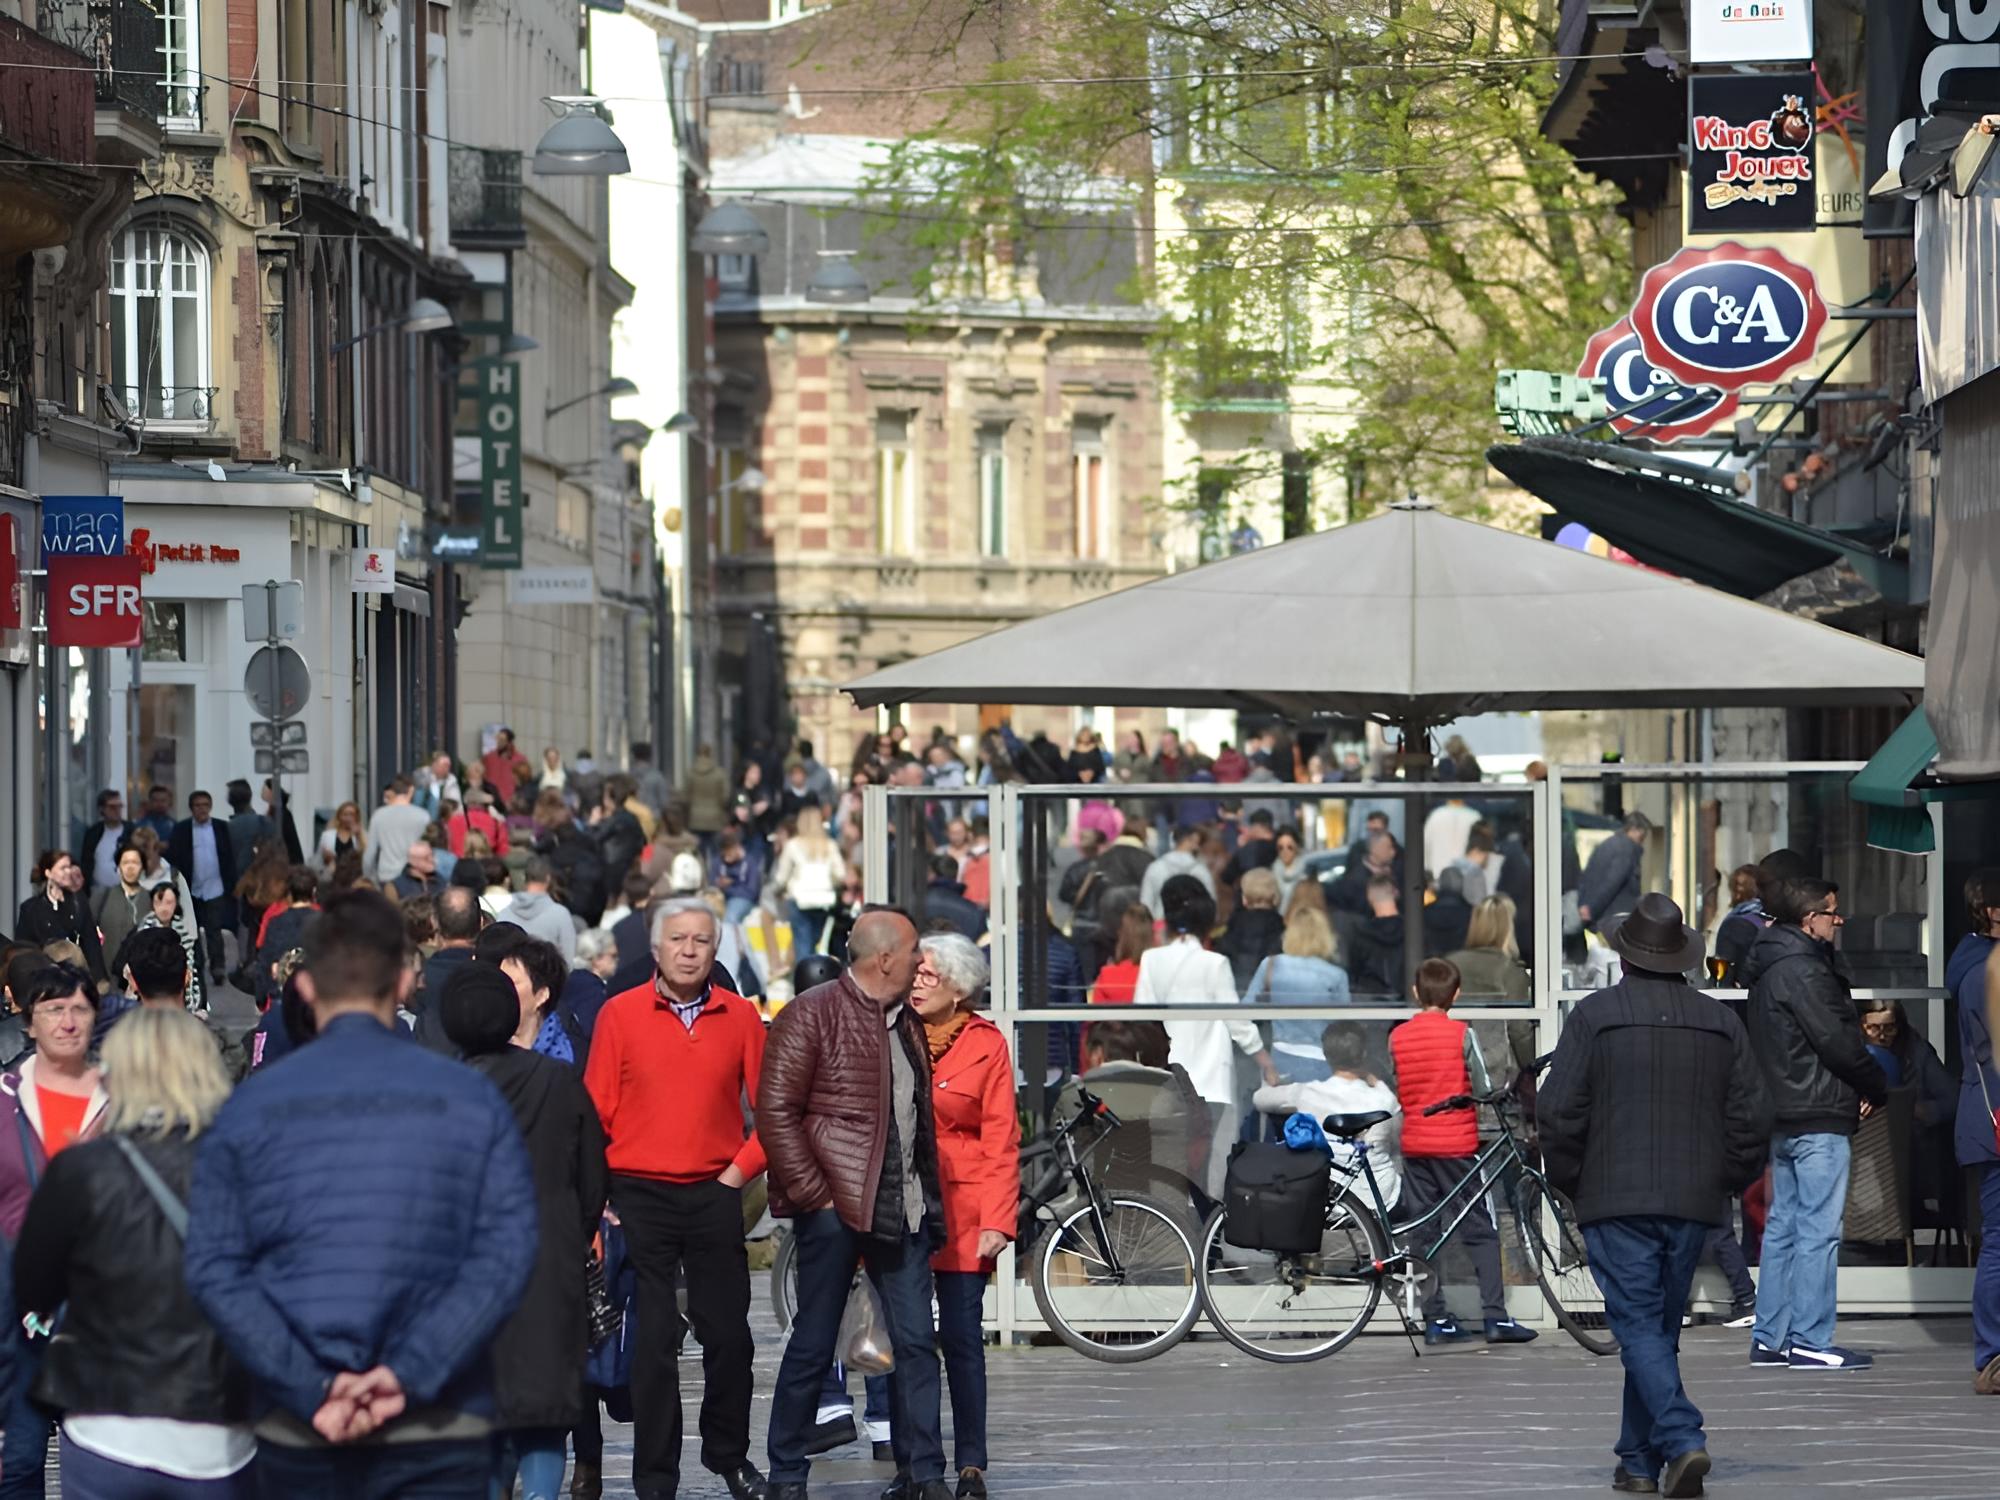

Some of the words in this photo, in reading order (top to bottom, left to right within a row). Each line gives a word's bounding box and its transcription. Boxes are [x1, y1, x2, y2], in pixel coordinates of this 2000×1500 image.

[1717, 151, 1812, 181] Jouet
[1672, 285, 1791, 345] C&A
[487, 365, 515, 545] HOTEL
[68, 583, 142, 617] SFR
